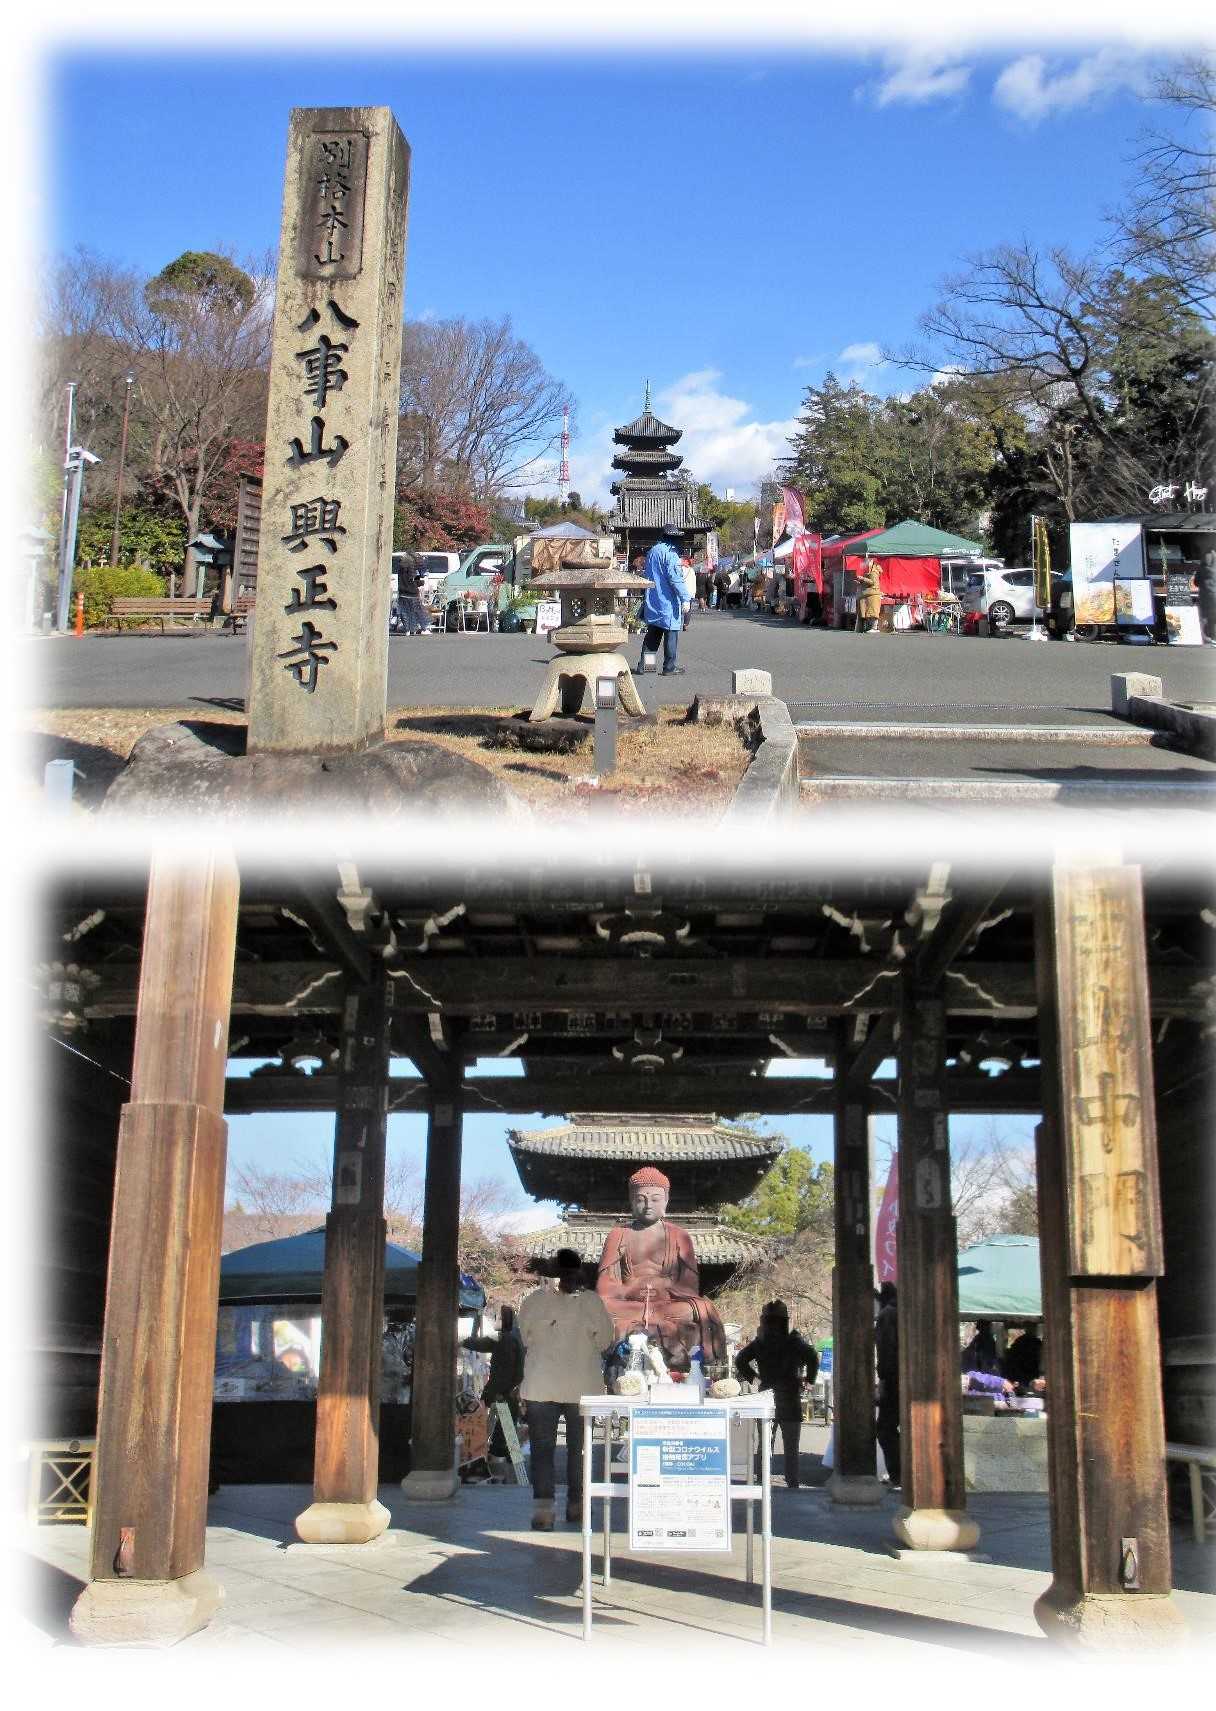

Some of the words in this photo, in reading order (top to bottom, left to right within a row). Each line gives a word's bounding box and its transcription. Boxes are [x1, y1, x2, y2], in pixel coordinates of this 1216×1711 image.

[315, 139, 352, 265] 別格本山
[277, 299, 361, 694] 八事山興正寺
